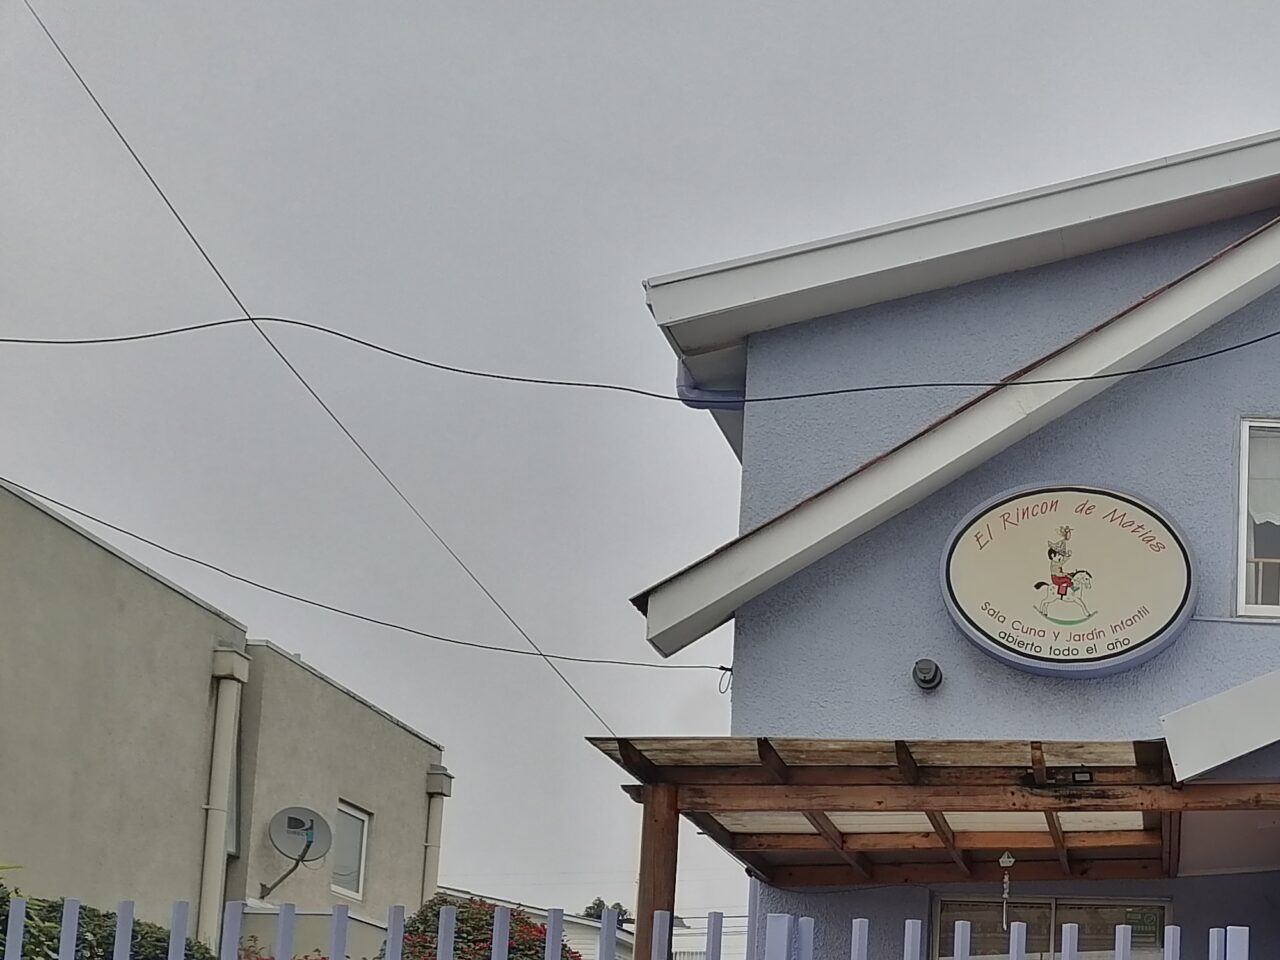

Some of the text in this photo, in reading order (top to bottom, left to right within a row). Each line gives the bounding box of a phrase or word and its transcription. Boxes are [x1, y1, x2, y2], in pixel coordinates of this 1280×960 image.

[974, 523, 993, 551] El
[1074, 499, 1096, 515] de
[981, 601, 1006, 624] Sala
[1011, 620, 1046, 638] Cuna
[1110, 605, 1150, 635] Infantil
[998, 630, 1131, 657] abierto todo el año
